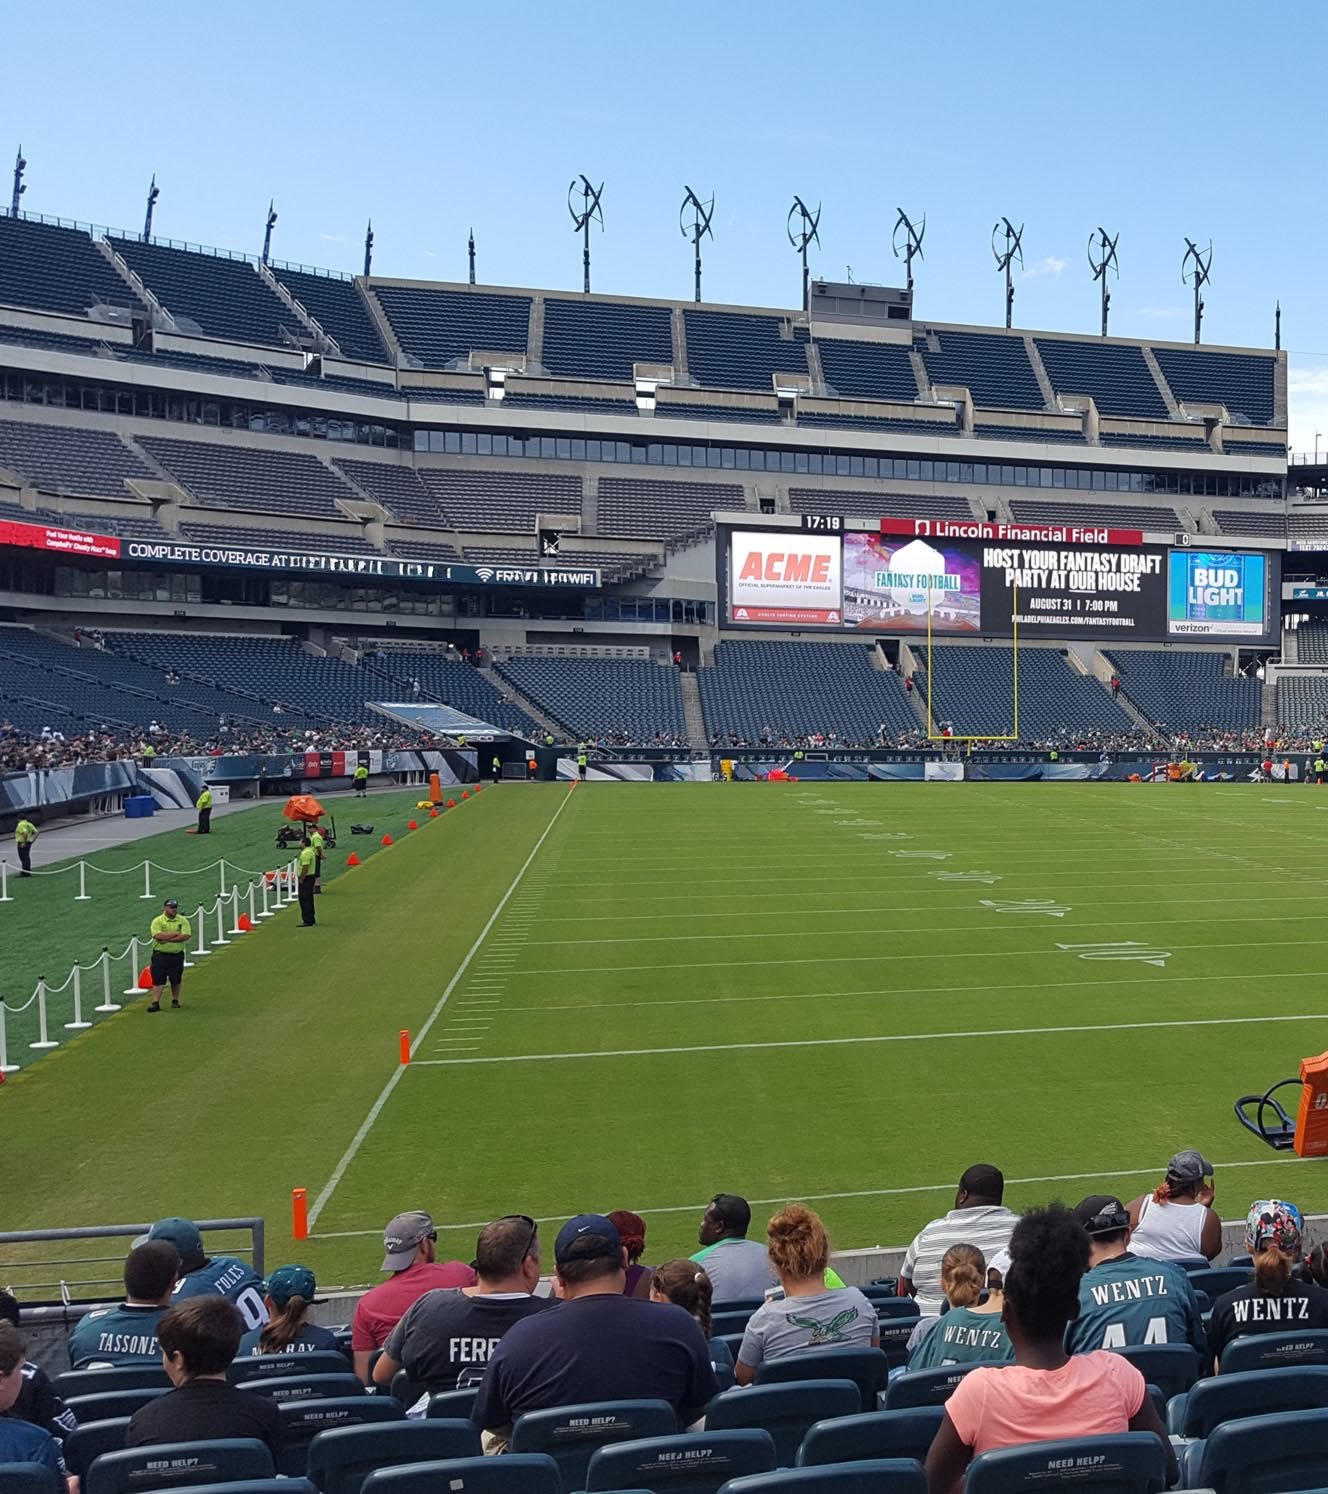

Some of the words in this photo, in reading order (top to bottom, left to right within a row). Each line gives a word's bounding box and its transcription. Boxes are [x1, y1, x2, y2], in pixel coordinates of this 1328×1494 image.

[806, 516, 840, 530] 17:19
[936, 522, 992, 539] Lincoln
[998, 525, 1067, 542] Financial
[1072, 530, 1108, 543] Field
[129, 543, 200, 561] COMPLETE
[202, 549, 270, 567] COVERAGE
[272, 555, 289, 567] AT
[984, 548, 1021, 568] HOST
[1022, 550, 1059, 570] YOUR
[1060, 552, 1119, 572] FANTASY
[1121, 554, 1162, 574] DRAFT
[739, 552, 831, 582] ACME
[877, 572, 914, 588] FANTASY
[1006, 568, 1051, 589] PARTY
[1051, 570, 1066, 589] AT
[1069, 571, 1096, 591] OUR
[1098, 572, 1141, 592] HOUSE
[1194, 568, 1239, 588] BUD
[1030, 598, 1061, 610] AUGUST
[1062, 599, 1072, 610] 31
[1085, 600, 1103, 611] 7:00
[1104, 601, 1118, 612] PM
[1189, 587, 1244, 606] LIGHT
[1175, 623, 1210, 633] verizon
[214, 1264, 245, 1295] FOLES
[1091, 1275, 1168, 1306] WENTZ
[1232, 1297, 1309, 1323] WENTZ
[98, 1332, 159, 1355] TASSONE
[944, 1326, 1001, 1349] WENTZ
[569, 1417, 590, 1427] NEED
[591, 1416, 617, 1425] HELP?
[146, 1460, 169, 1469] NEED
[171, 1458, 199, 1468] HELP?
[684, 1449, 713, 1458] HELP?
[1048, 1459, 1074, 1470] NEED
[1076, 1455, 1106, 1467] HELP?
